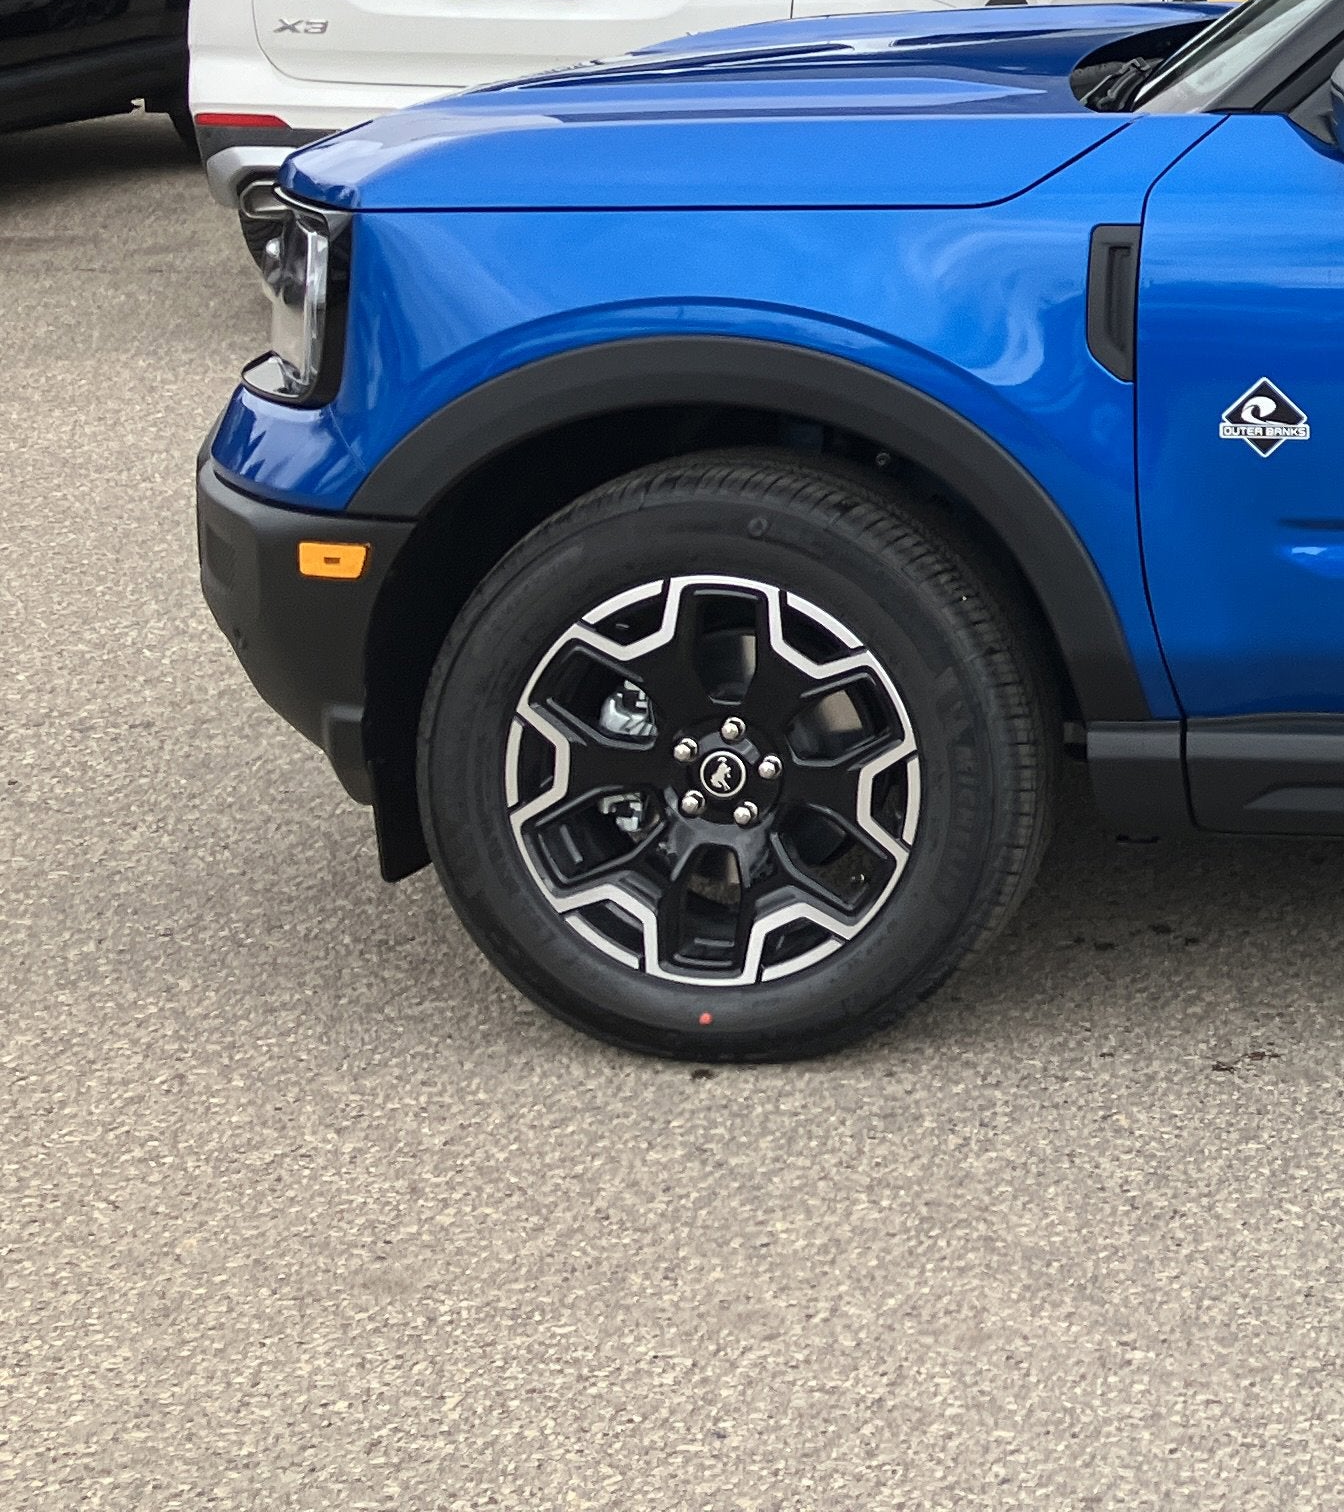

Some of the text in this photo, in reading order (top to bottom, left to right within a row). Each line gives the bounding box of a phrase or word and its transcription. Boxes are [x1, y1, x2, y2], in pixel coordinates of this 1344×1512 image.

[273, 19, 329, 34] X3
[1223, 426, 1306, 437] OUTER BANKS
